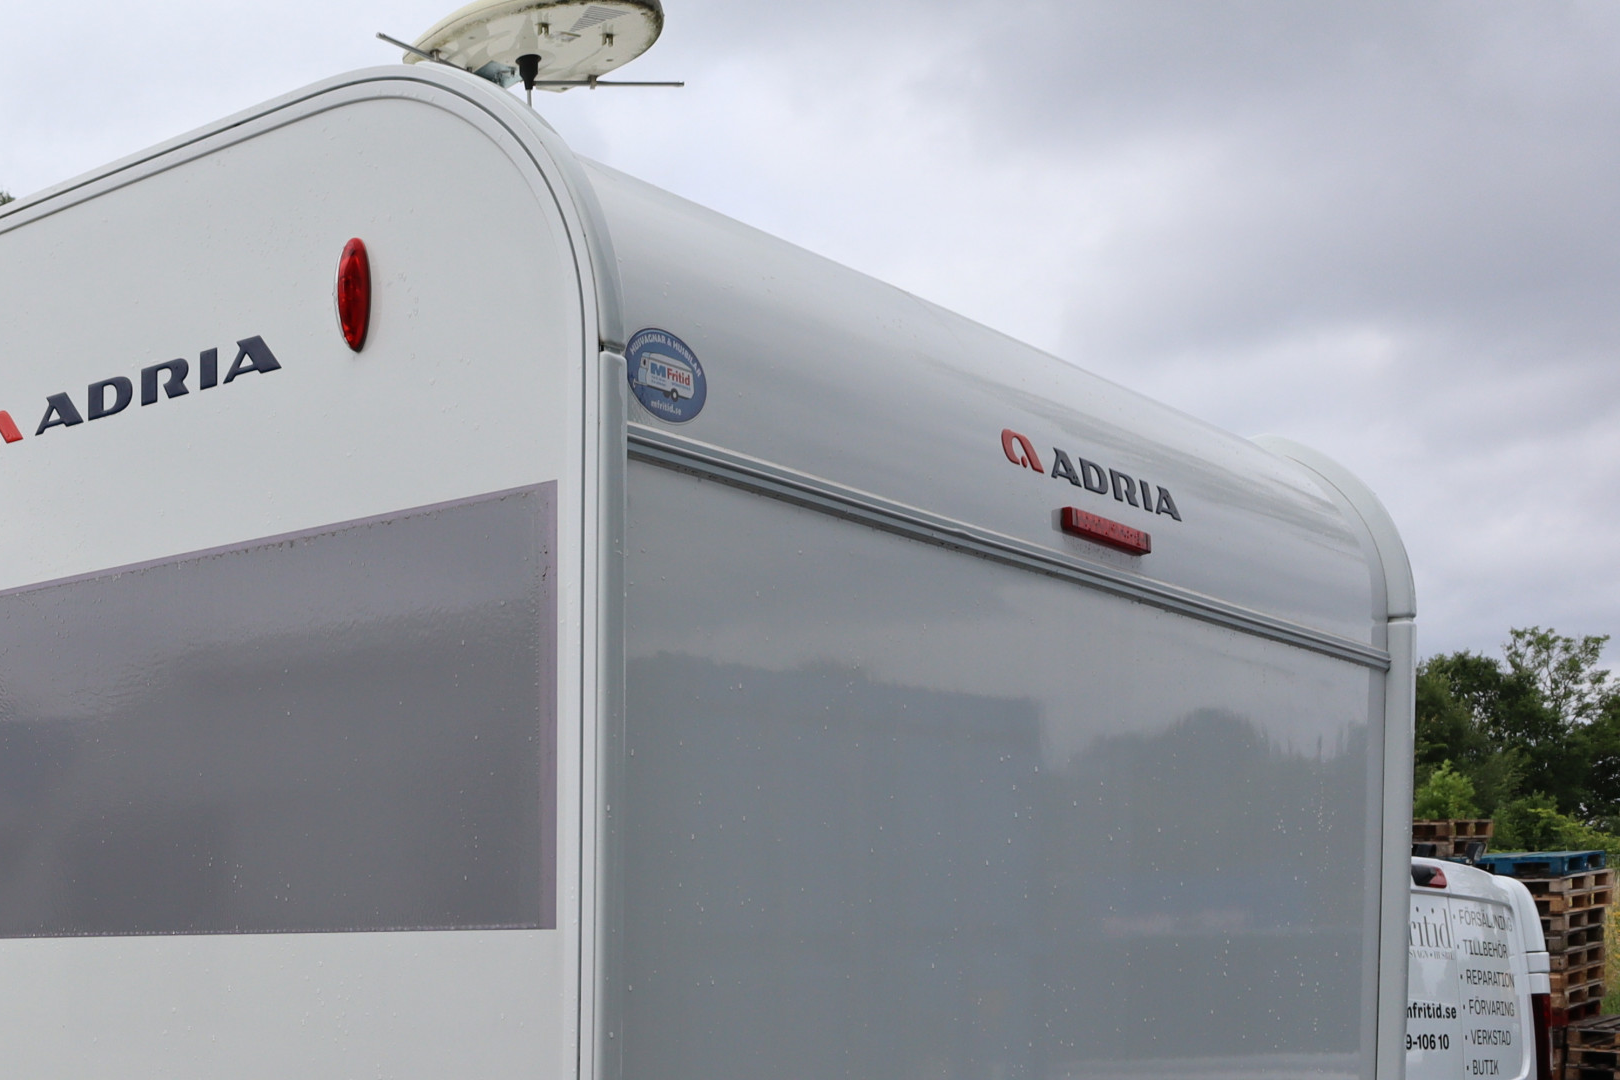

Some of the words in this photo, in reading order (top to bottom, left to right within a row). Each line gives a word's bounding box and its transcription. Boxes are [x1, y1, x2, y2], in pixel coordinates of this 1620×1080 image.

[629, 334, 667, 356] HUSVAGNAR
[673, 340, 702, 377] HUSBILAR
[35, 334, 282, 436] ADRIA
[650, 400, 682, 416] mfritid.se
[1051, 447, 1182, 522] ADRIA
[1463, 939, 1508, 959] TILLBEHÖR
[1465, 968, 1515, 989] REPARATION
[1468, 996, 1515, 1018] FÖRVARING
[1470, 1029, 1512, 1047] VERKSTAD
[1472, 1059, 1499, 1076] BUTIK
